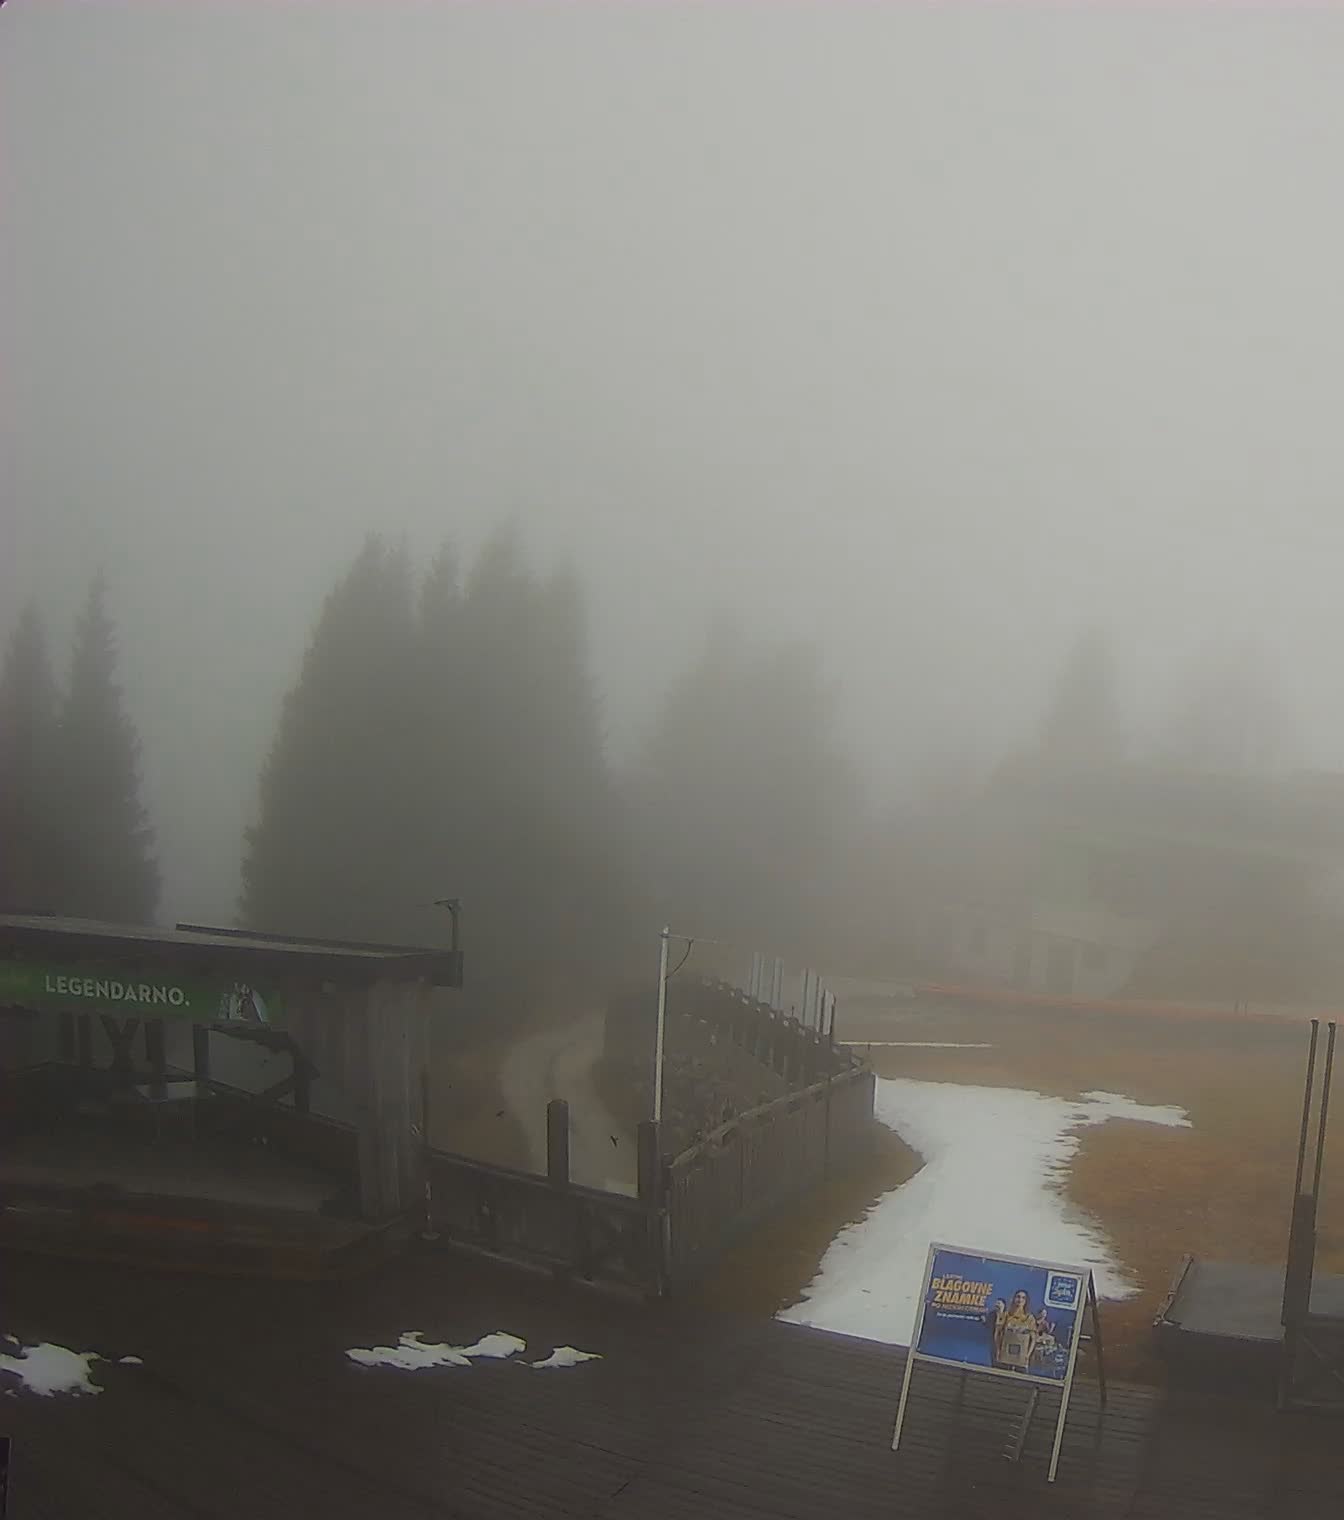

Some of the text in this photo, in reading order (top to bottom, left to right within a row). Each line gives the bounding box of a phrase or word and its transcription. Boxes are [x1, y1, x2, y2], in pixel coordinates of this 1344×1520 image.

[45, 975, 191, 1007] LEGENDARNO.
[932, 1278, 993, 1295] BLAGOVNE
[934, 1291, 986, 1306] ZNAMKE
